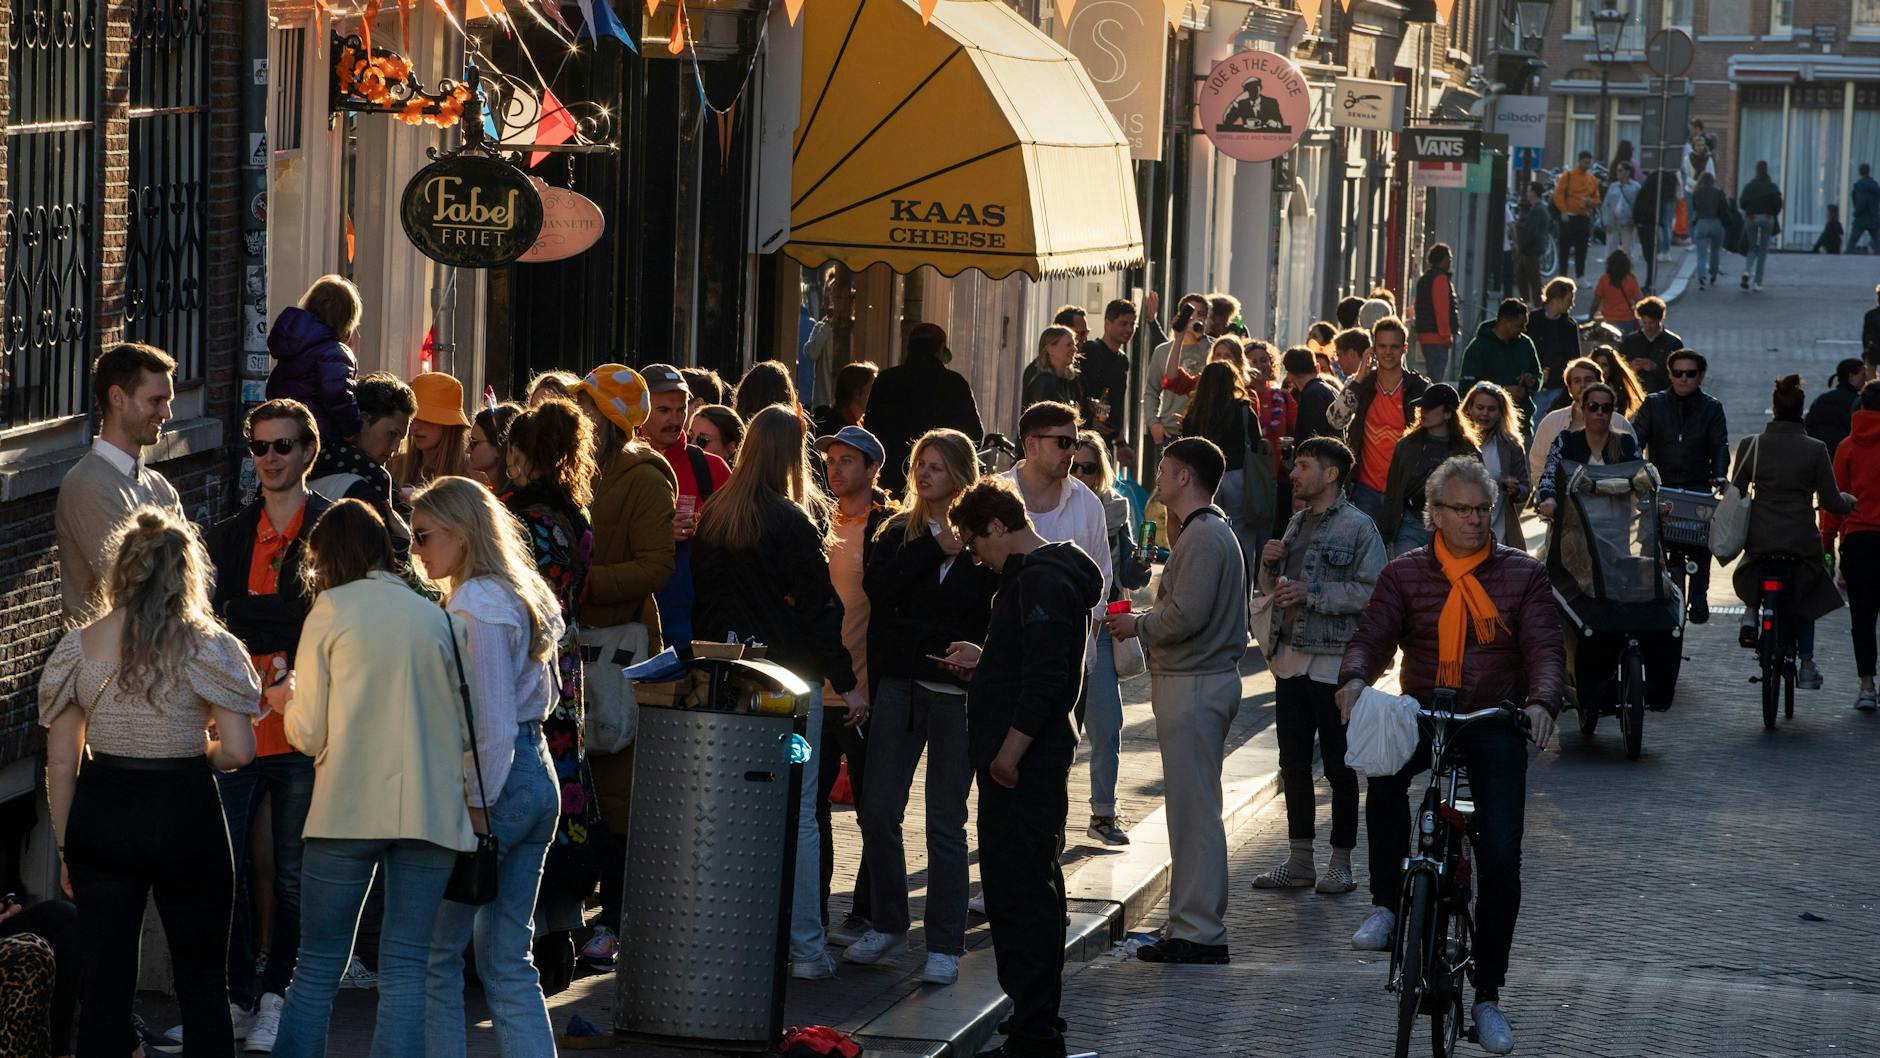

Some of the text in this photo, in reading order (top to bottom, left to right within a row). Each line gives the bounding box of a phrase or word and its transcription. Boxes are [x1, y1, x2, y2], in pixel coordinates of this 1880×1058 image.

[1208, 58, 1302, 97] JOE & THE JUICE
[1415, 135, 1465, 157] VANS
[424, 176, 519, 229] Fabel
[890, 199, 1006, 227] KAAS
[442, 230, 505, 247] FRIET
[889, 227, 1006, 249] CHEESE
